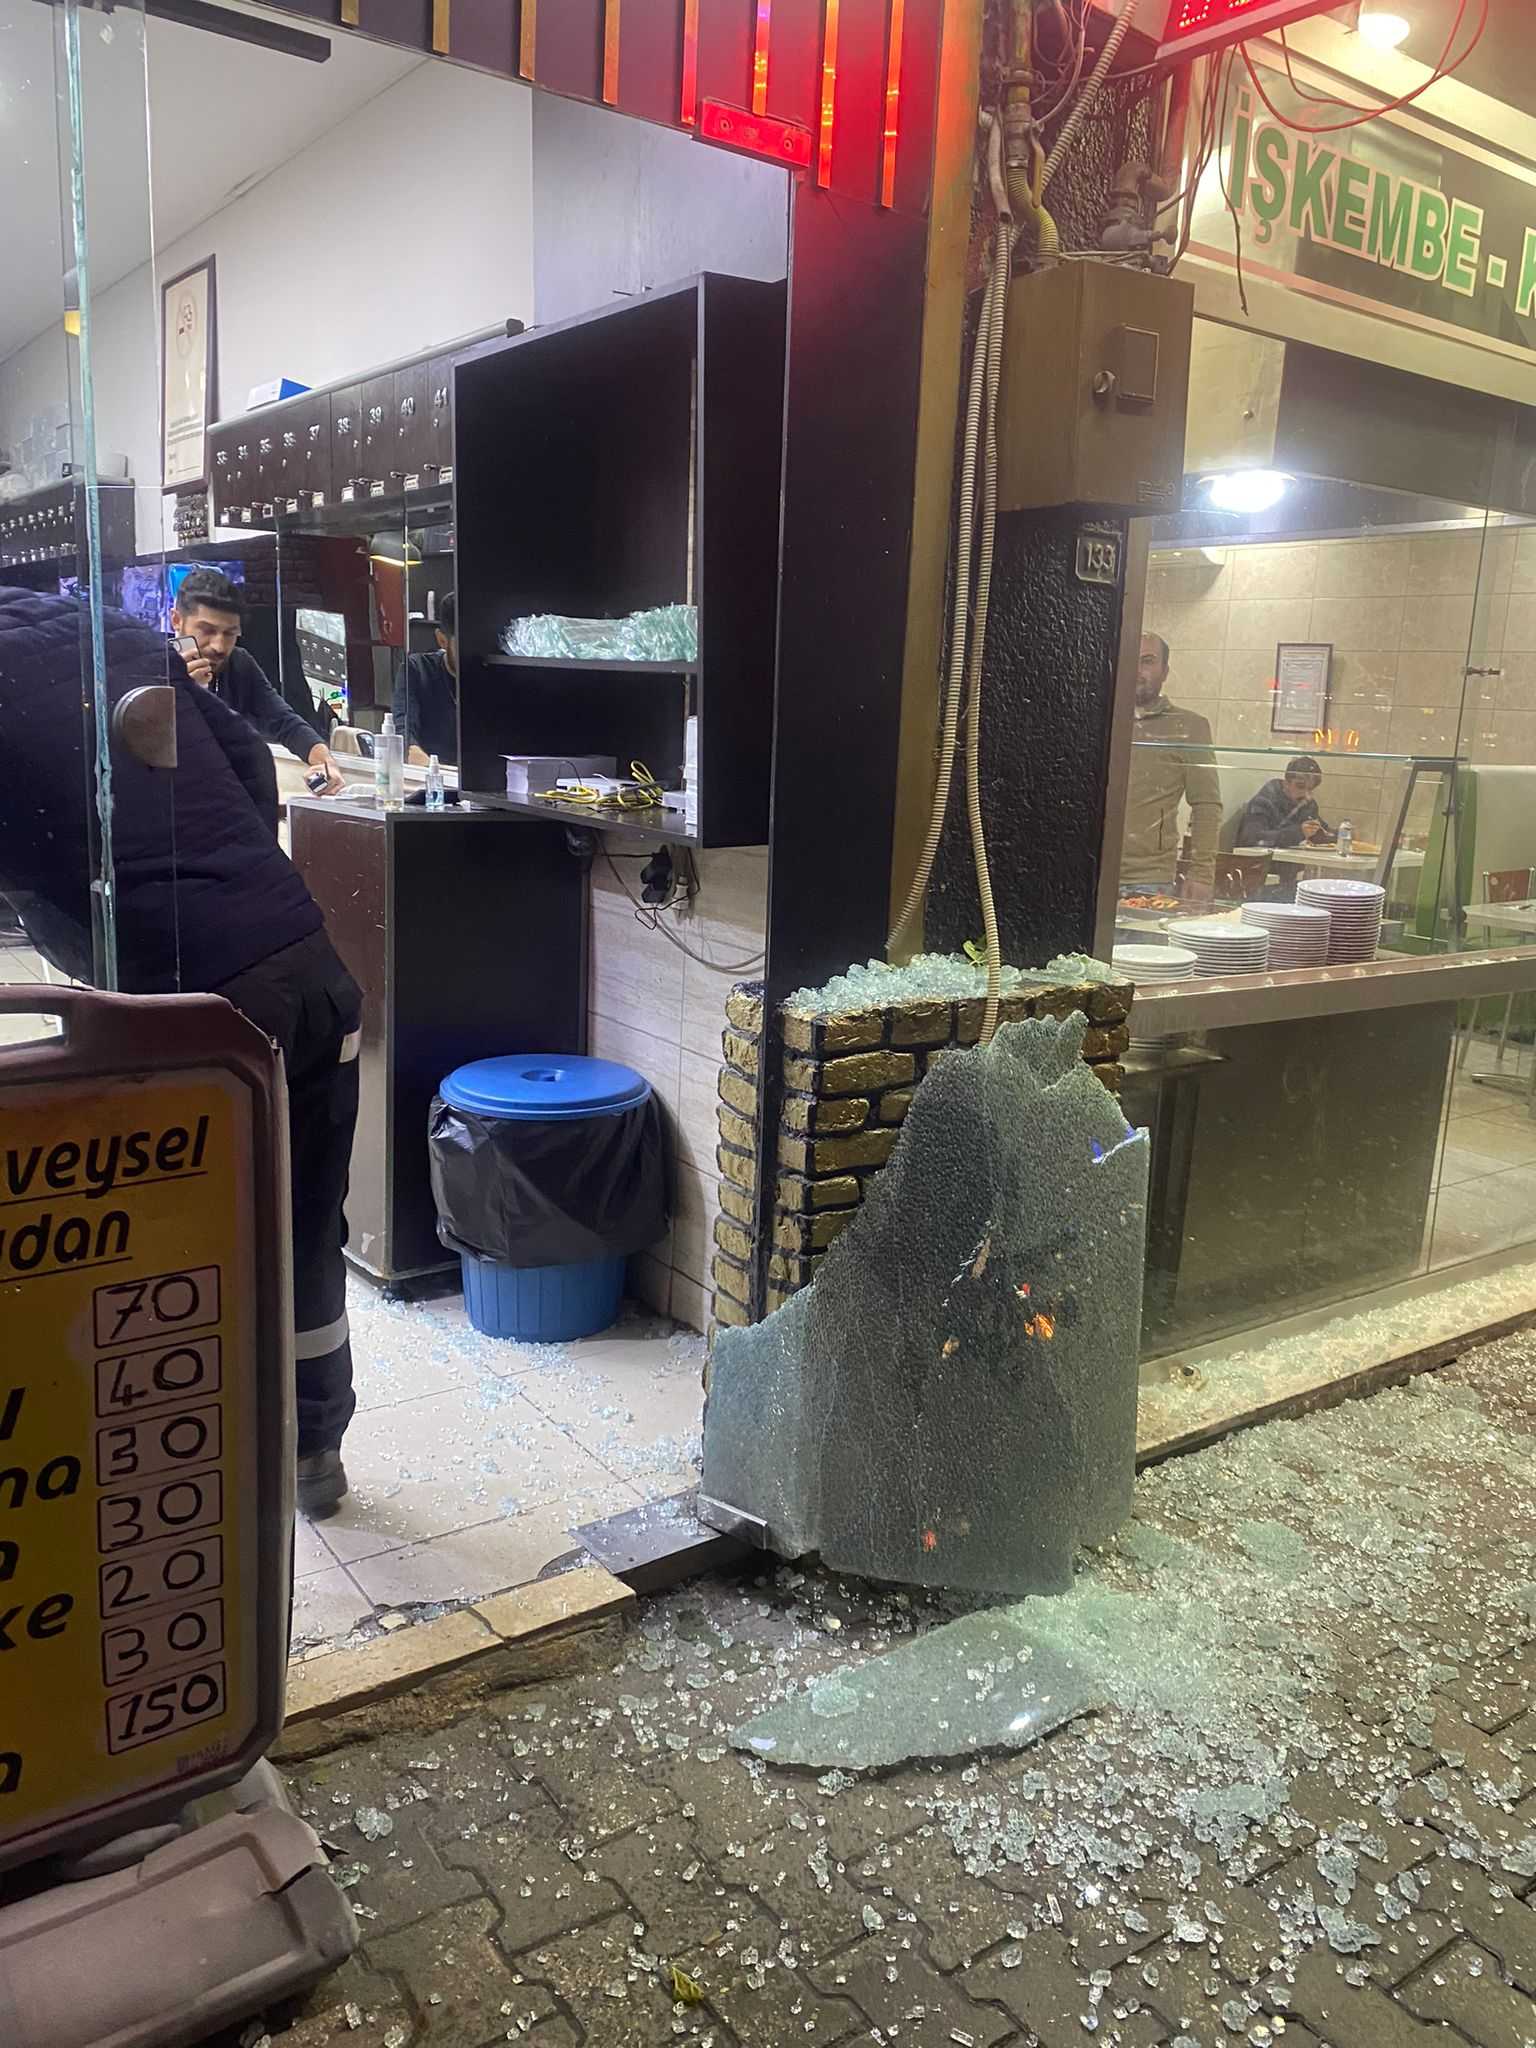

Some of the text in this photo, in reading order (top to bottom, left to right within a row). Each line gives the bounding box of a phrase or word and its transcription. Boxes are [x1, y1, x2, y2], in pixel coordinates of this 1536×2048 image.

[1225, 85, 1484, 297] İŞKEMBE
[400, 396, 415, 417] 40
[434, 386, 448, 409] 41
[1087, 542, 1116, 570] 133
[6, 1115, 210, 1200] veysel
[0, 1209, 130, 1272] dan
[106, 1274, 200, 1340] 70
[109, 1347, 205, 1407] 40
[108, 1415, 208, 1477] 30
[105, 1480, 203, 1549] 30
[103, 1549, 206, 1608] 20
[106, 1611, 208, 1677] 30
[116, 1673, 220, 1741] 150
